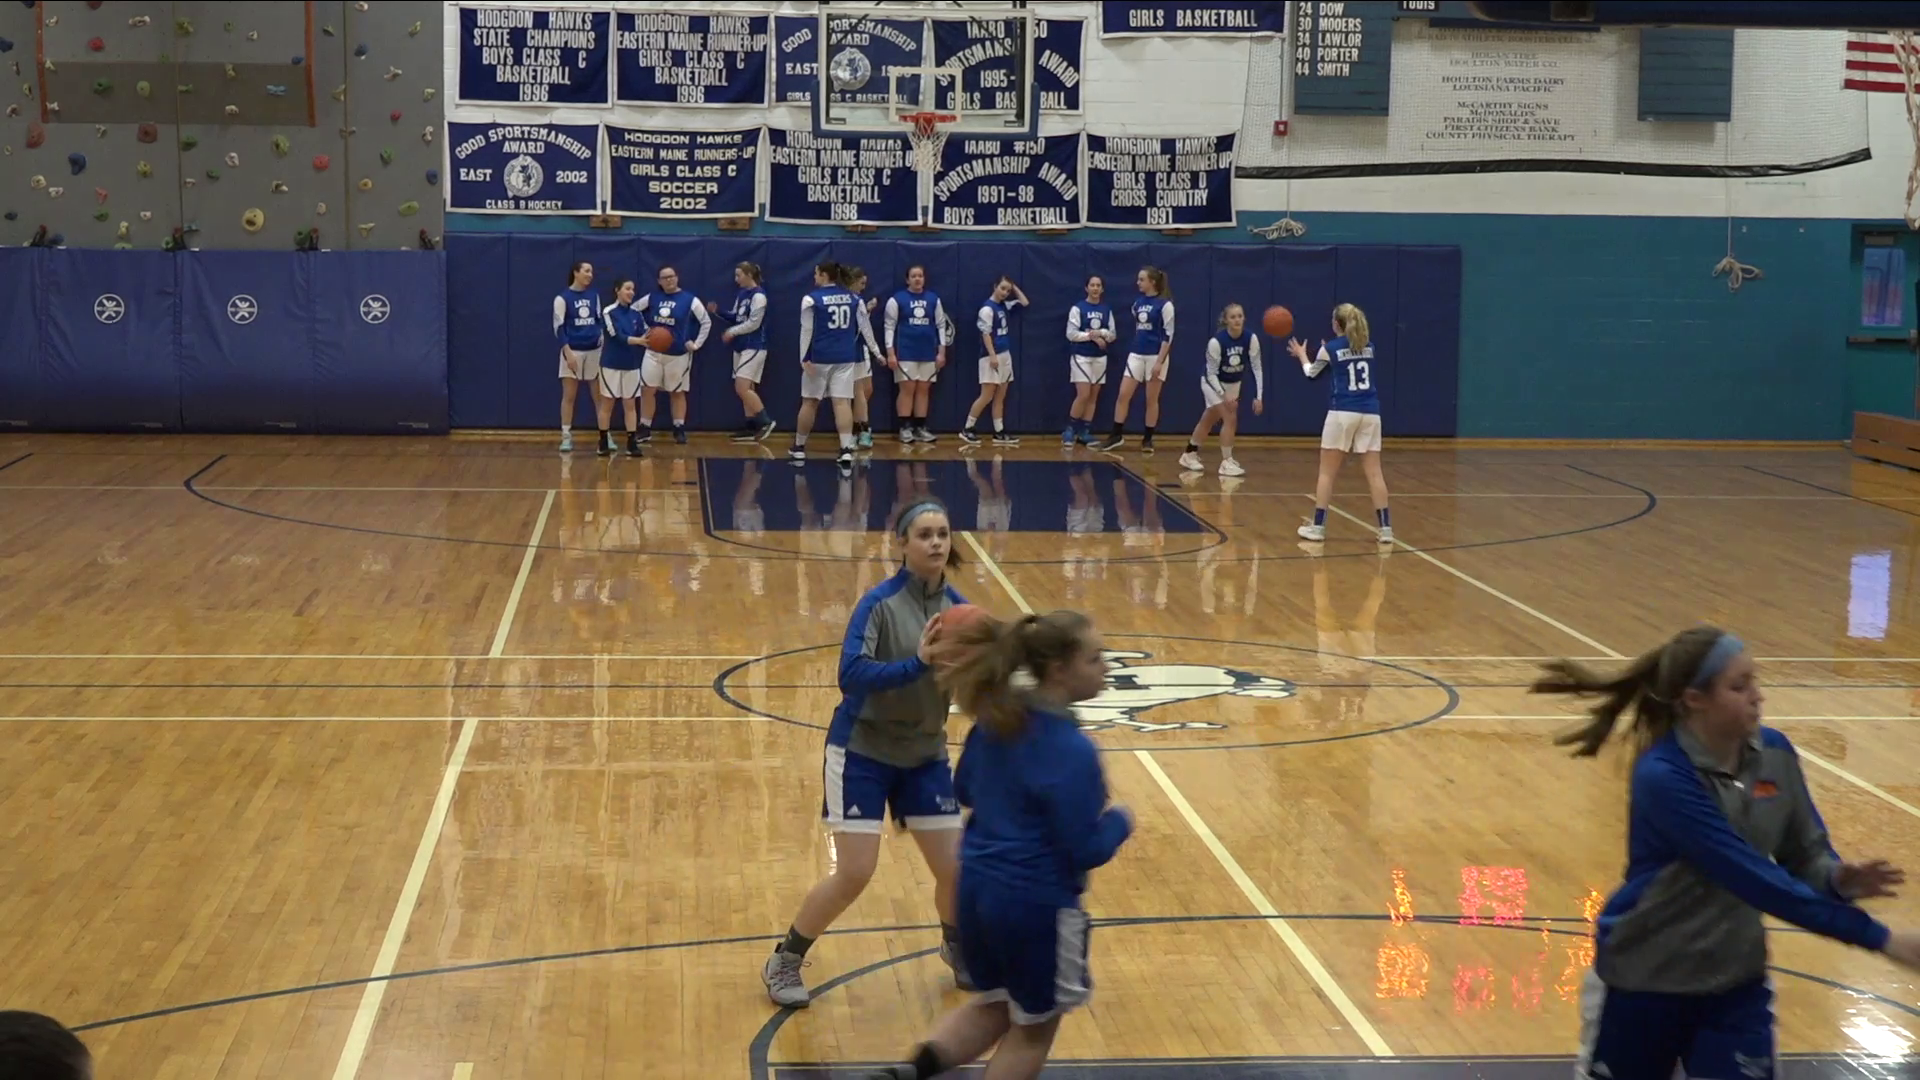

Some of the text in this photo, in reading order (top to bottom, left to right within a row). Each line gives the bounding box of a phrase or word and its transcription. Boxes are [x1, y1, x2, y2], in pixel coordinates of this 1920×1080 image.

[1299, 2, 1344, 16] 24 DOW
[477, 9, 593, 30] HODGDON HAWKS
[634, 14, 750, 34] HODGDON HAWKS
[1129, 9, 1257, 27] GIRLS BASKETBALL
[1298, 18, 1362, 32] 30 MOOERS
[474, 28, 595, 49] STATE CHAMPIONS
[617, 31, 665, 49] EASTERN
[668, 32, 703, 51] MAINE
[781, 28, 812, 53] GOOD
[1297, 32, 1362, 47] 34 LAWLOR
[482, 47, 586, 68] BOYS CLASS C
[639, 50, 745, 69] GIRLS CLASS C
[1296, 47, 1359, 62] 40 PORTER
[496, 65, 571, 85] BASKETBALL
[655, 67, 728, 86] BASKETBALL
[785, 62, 819, 75] EAST
[1038, 49, 1080, 88] AWARD
[1295, 63, 1349, 77] 44 SMITH
[1442, 76, 1492, 84] HOULTON
[1534, 78, 1565, 86] DAIRY
[1453, 84, 1555, 93] LOUISIANA PACIFIC
[519, 84, 549, 101] 1996
[677, 85, 705, 103] 1996
[786, 92, 811, 101] GIRLS
[856, 94, 908, 103] BASKETALL
[1517, 102, 1549, 110] SIGNS
[1445, 124, 1476, 132] FIRST
[1491, 117, 1520, 125] SHOP
[455, 126, 592, 160] GOOD SPORTSMANSHIP
[624, 132, 743, 144] HODGDON HAWKS
[1105, 136, 1217, 155] HODGDON HAWKS
[1527, 133, 1575, 141] THERAPY
[502, 141, 545, 154] AWARD
[611, 144, 654, 160] EASTERN
[659, 148, 688, 161] MAINE
[770, 145, 816, 166] EASTERN
[820, 149, 857, 167] MAINE
[859, 150, 903, 168] RUNNER
[1088, 151, 1233, 172] EASTERN MAINE RUNNER UP
[459, 168, 588, 183] EAST 2002
[630, 163, 737, 178] GIRLS CLASS C
[798, 167, 891, 185] GIRLS CLASS C
[934, 156, 1078, 202] SPORTSMANSHIP AWARD
[648, 181, 719, 194] SOCCER
[1113, 172, 1145, 189] GIRLS
[1155, 172, 1191, 190] CLASS
[807, 184, 881, 203] BASKETBALL
[1111, 189, 1208, 207] CROSS COUNTRY
[485, 199, 515, 209] CLASS
[528, 200, 562, 210] HOCKEY
[659, 197, 707, 209] 2002
[830, 203, 858, 220] 1998
[944, 206, 1068, 225] BOYS BASKETBALL
[574, 299, 590, 308] LADY
[910, 300, 927, 308] LADY
[828, 305, 850, 329] 30
[1347, 361, 1370, 391] 13
